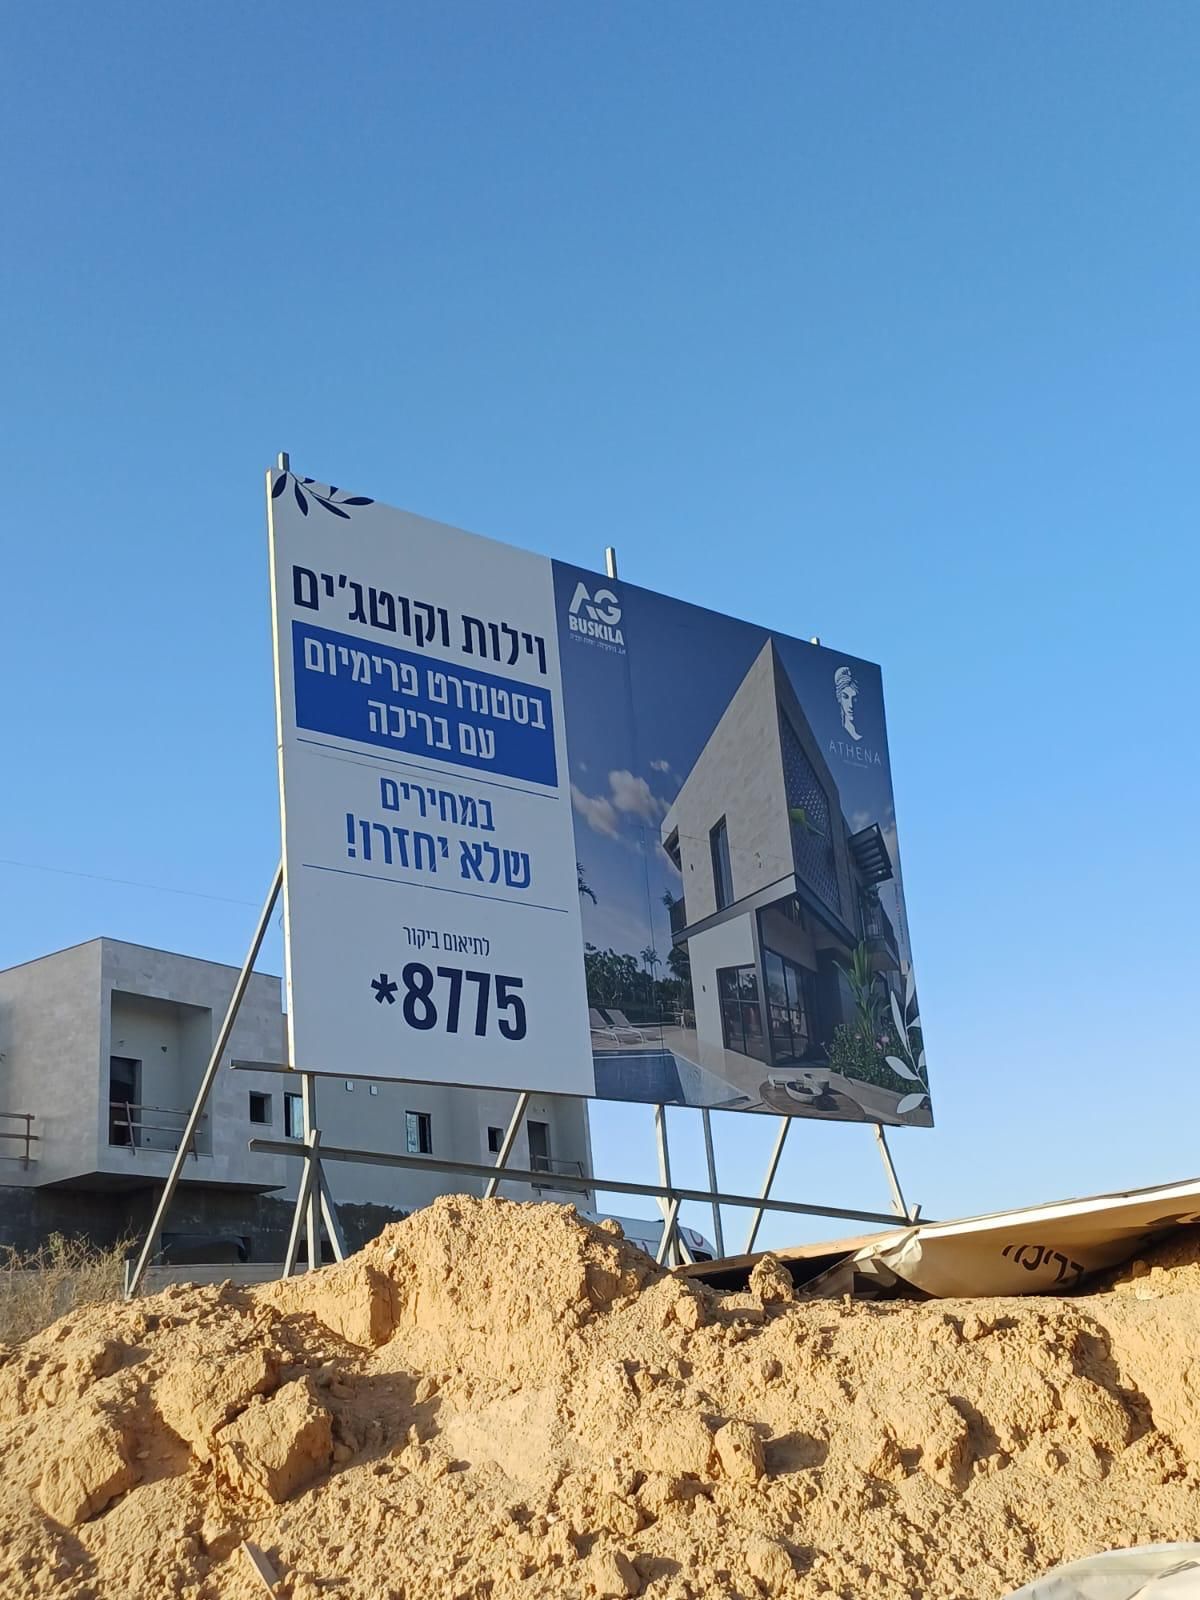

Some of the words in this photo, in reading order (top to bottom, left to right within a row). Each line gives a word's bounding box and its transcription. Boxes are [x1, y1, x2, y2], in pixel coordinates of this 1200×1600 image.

[292, 564, 450, 648] וקוטג'ים
[568, 614, 625, 646] BUSKILA
[304, 637, 419, 697] פרימיום
[461, 614, 547, 675] וילות
[426, 669, 546, 730] בסטנדרט
[368, 700, 451, 751] בריכה
[458, 722, 496, 760] עם
[829, 740, 882, 766] ATHENA
[380, 777, 495, 832] במחירים
[346, 813, 450, 873] יחזרו!
[459, 841, 531, 889] שלא
[402, 926, 439, 950] ביקור
[443, 931, 490, 957] לתיאום
